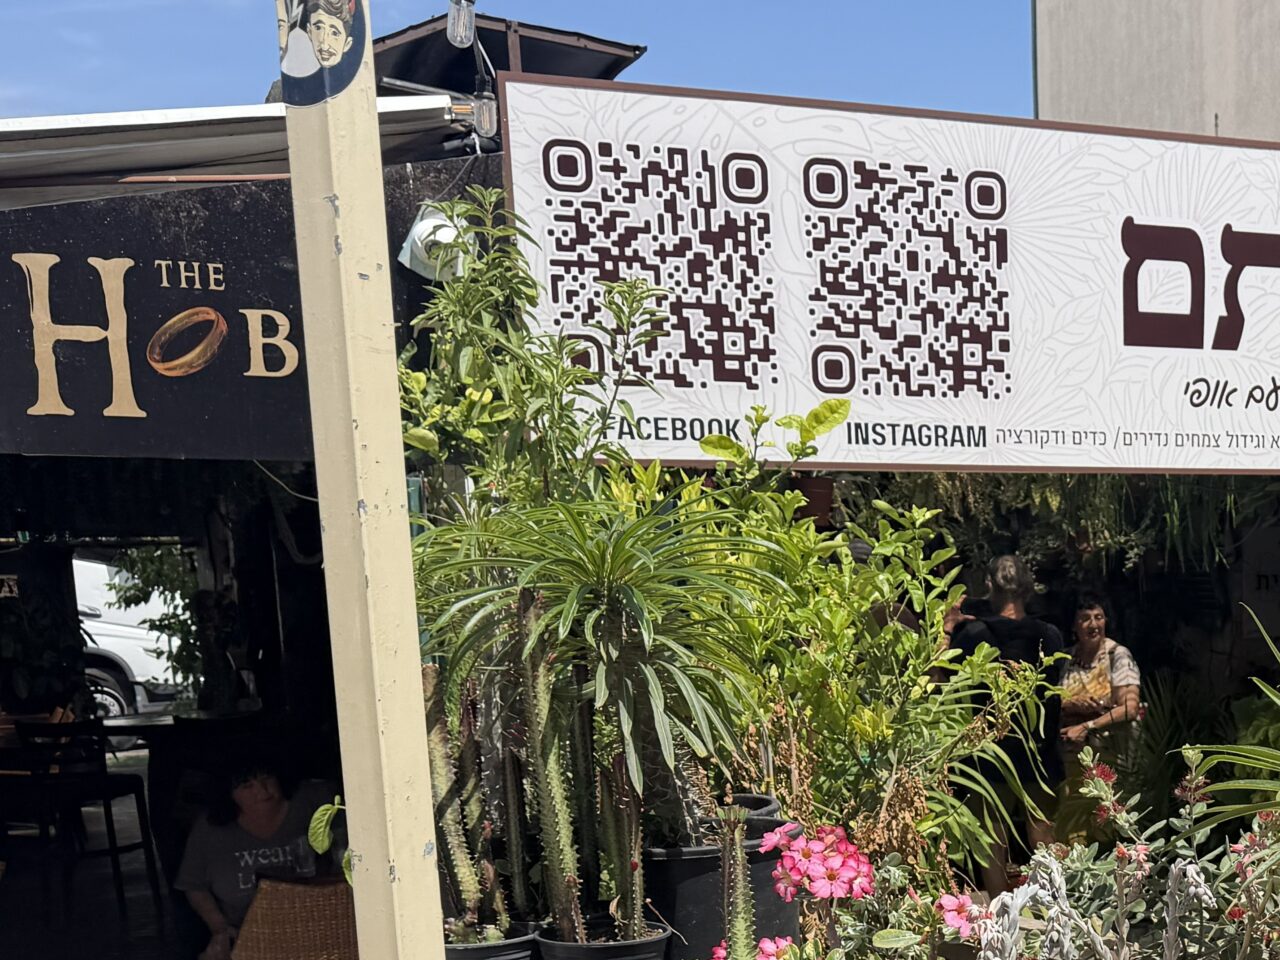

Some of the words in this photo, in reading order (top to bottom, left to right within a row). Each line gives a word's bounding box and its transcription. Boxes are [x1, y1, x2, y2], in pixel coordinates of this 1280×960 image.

[154, 258, 226, 291] THE
[1184, 377, 1239, 410] אופי
[846, 420, 987, 448] INSTAGRAM
[996, 427, 1067, 450] ודקורציה
[1072, 429, 1107, 447] כדים
[1174, 430, 1222, 448] צמחים
[1226, 430, 1266, 450] וגידול
